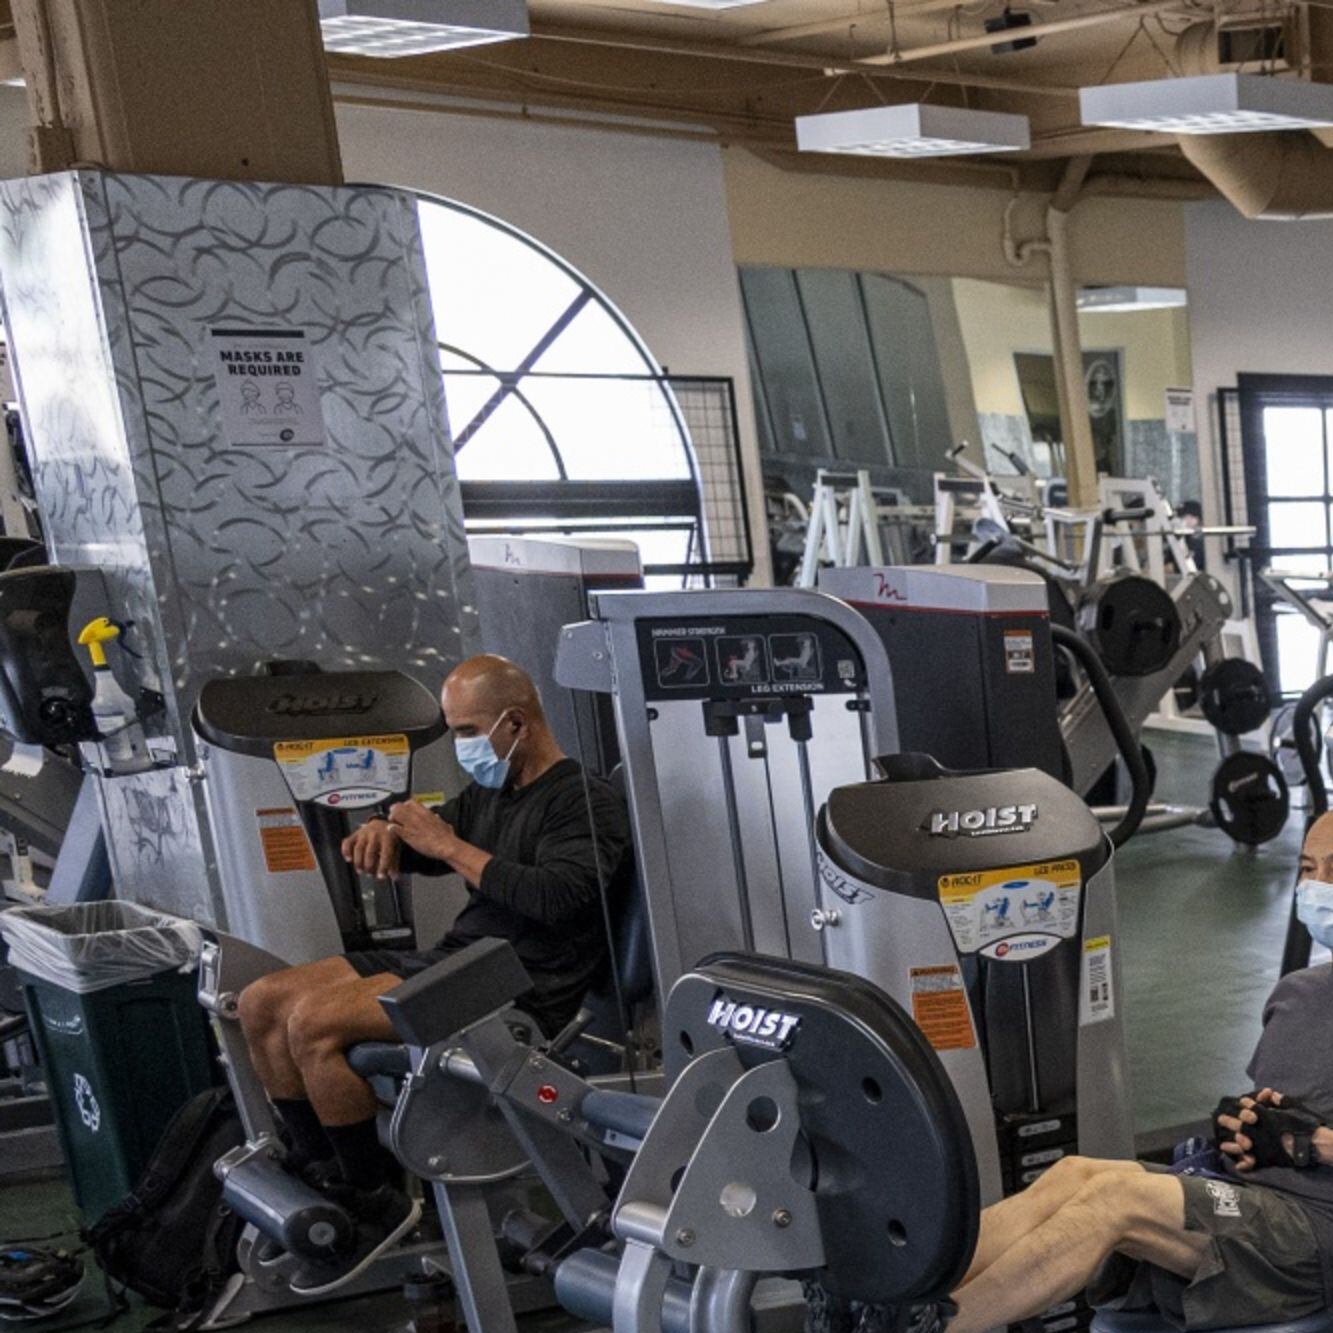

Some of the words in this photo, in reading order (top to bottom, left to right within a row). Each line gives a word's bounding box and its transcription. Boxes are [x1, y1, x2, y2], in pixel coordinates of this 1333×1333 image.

[220, 351, 273, 362] MASKS
[277, 351, 304, 363] ARE
[227, 364, 301, 376] REQUIRED
[751, 685, 771, 693] LEG
[772, 682, 824, 693] EXTENSION
[931, 803, 1037, 833] HOIST
[1009, 939, 1048, 952] FITNESS
[707, 1000, 799, 1040] HOIST
